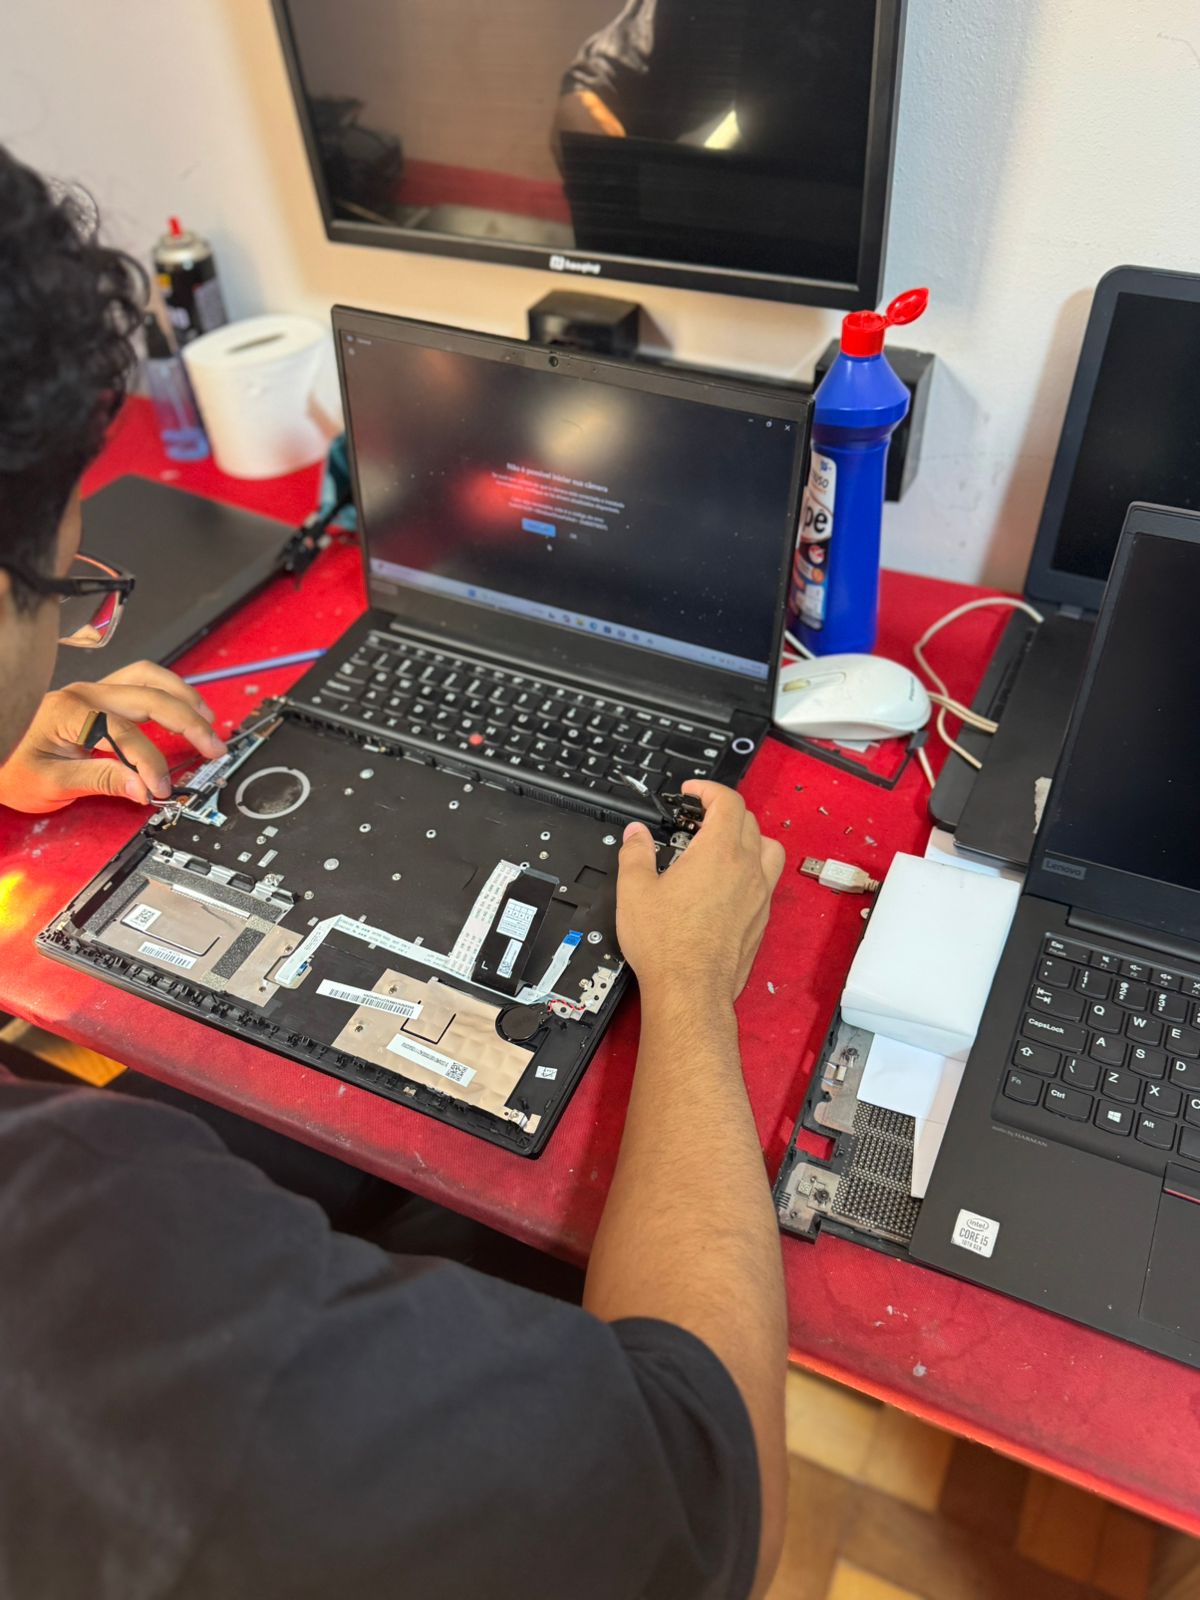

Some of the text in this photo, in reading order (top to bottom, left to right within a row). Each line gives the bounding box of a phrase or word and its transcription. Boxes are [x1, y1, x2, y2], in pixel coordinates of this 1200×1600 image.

[803, 505, 829, 535] pê
[1046, 859, 1081, 877] Lenovo
[1093, 1004, 1105, 1017] Q
[1028, 1018, 1065, 1034] CapsLock
[1133, 1016, 1147, 1028] W
[1171, 1028, 1182, 1039] E
[1096, 1037, 1107, 1047] A
[1135, 1048, 1146, 1059] S
[1175, 1061, 1186, 1071] D
[1011, 1076, 1021, 1085] Fn
[1108, 1072, 1119, 1083] Z
[1051, 1089, 1066, 1099] Ctrl
[1149, 1085, 1160, 1096] X
[1143, 1120, 1155, 1129] Alt
[959, 1227, 989, 1247] CORE i5
